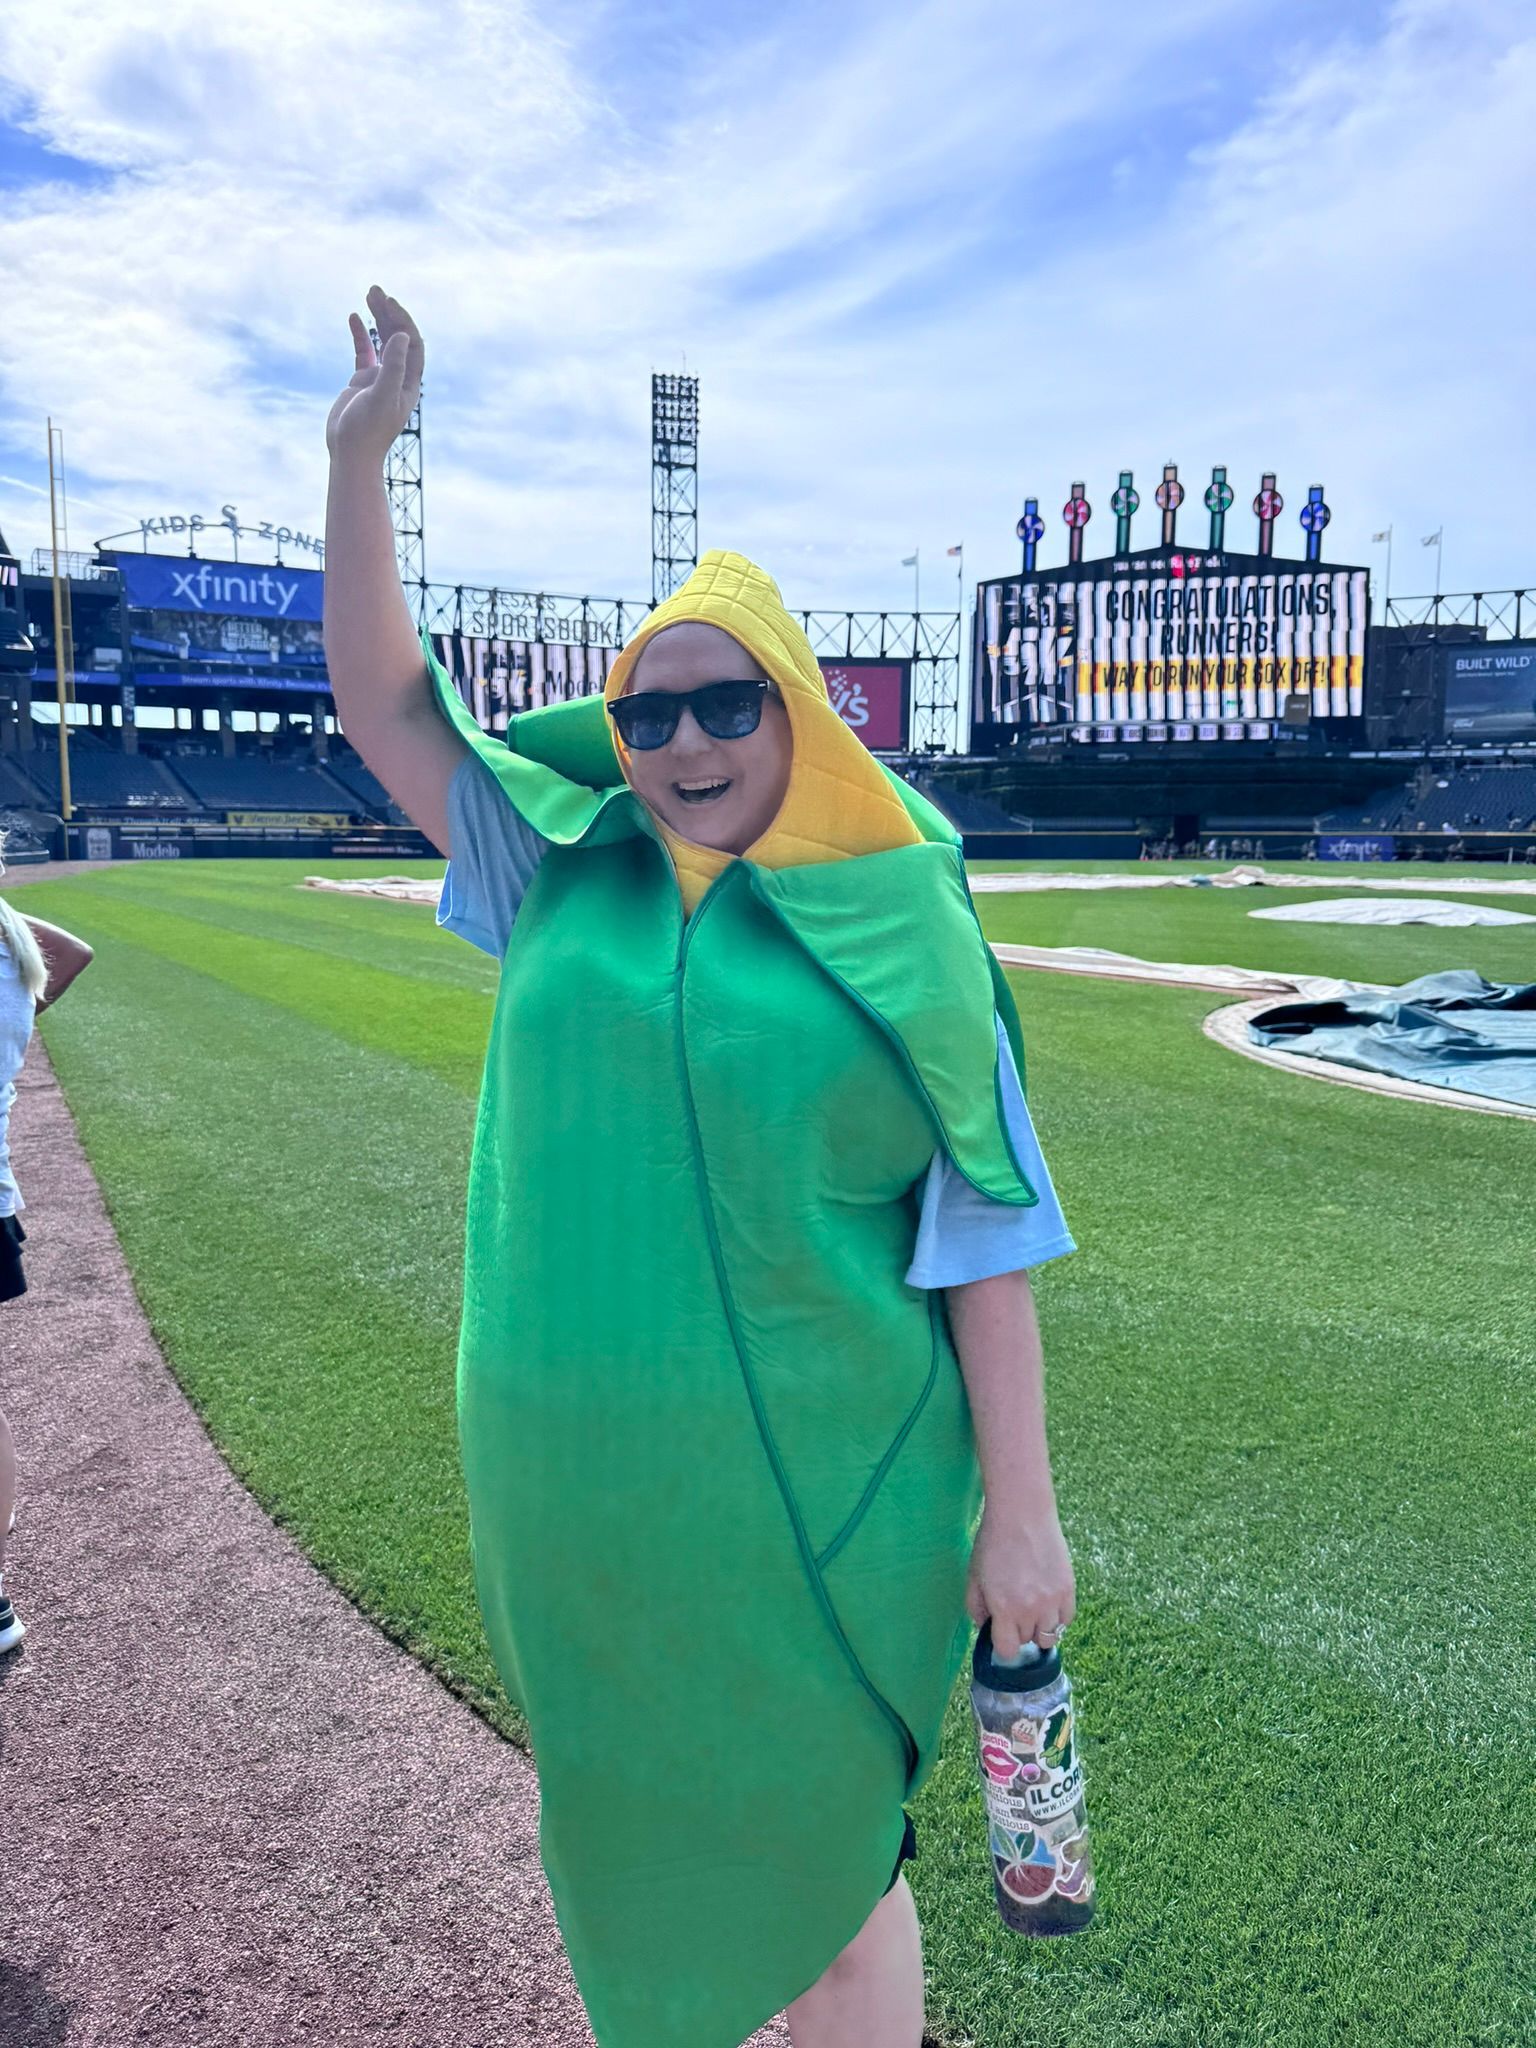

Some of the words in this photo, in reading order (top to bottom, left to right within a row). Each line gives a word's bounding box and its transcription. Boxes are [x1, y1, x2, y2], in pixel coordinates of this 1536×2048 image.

[140, 514, 205, 537] KIDS
[258, 521, 325, 555] ZONE
[172, 565, 299, 615] xfinity
[1106, 584, 1337, 620] CONGRATULATONS,
[472, 611, 613, 645] SPORTSBOOK
[1161, 621, 1275, 655] RUNNERS!
[1103, 664, 1139, 688] WAY
[1145, 664, 1163, 687] TO
[1168, 663, 1200, 686] RUN
[1205, 662, 1248, 685] YOUR
[1294, 660, 1326, 683] OFF!
[1456, 659, 1493, 671] BUILT
[1495, 655, 1531, 669] WILD
[546, 671, 605, 696] Model
[133, 842, 181, 859] Modelo
[1030, 1788, 1050, 1805] IL
[1051, 1766, 1080, 1798] COR
